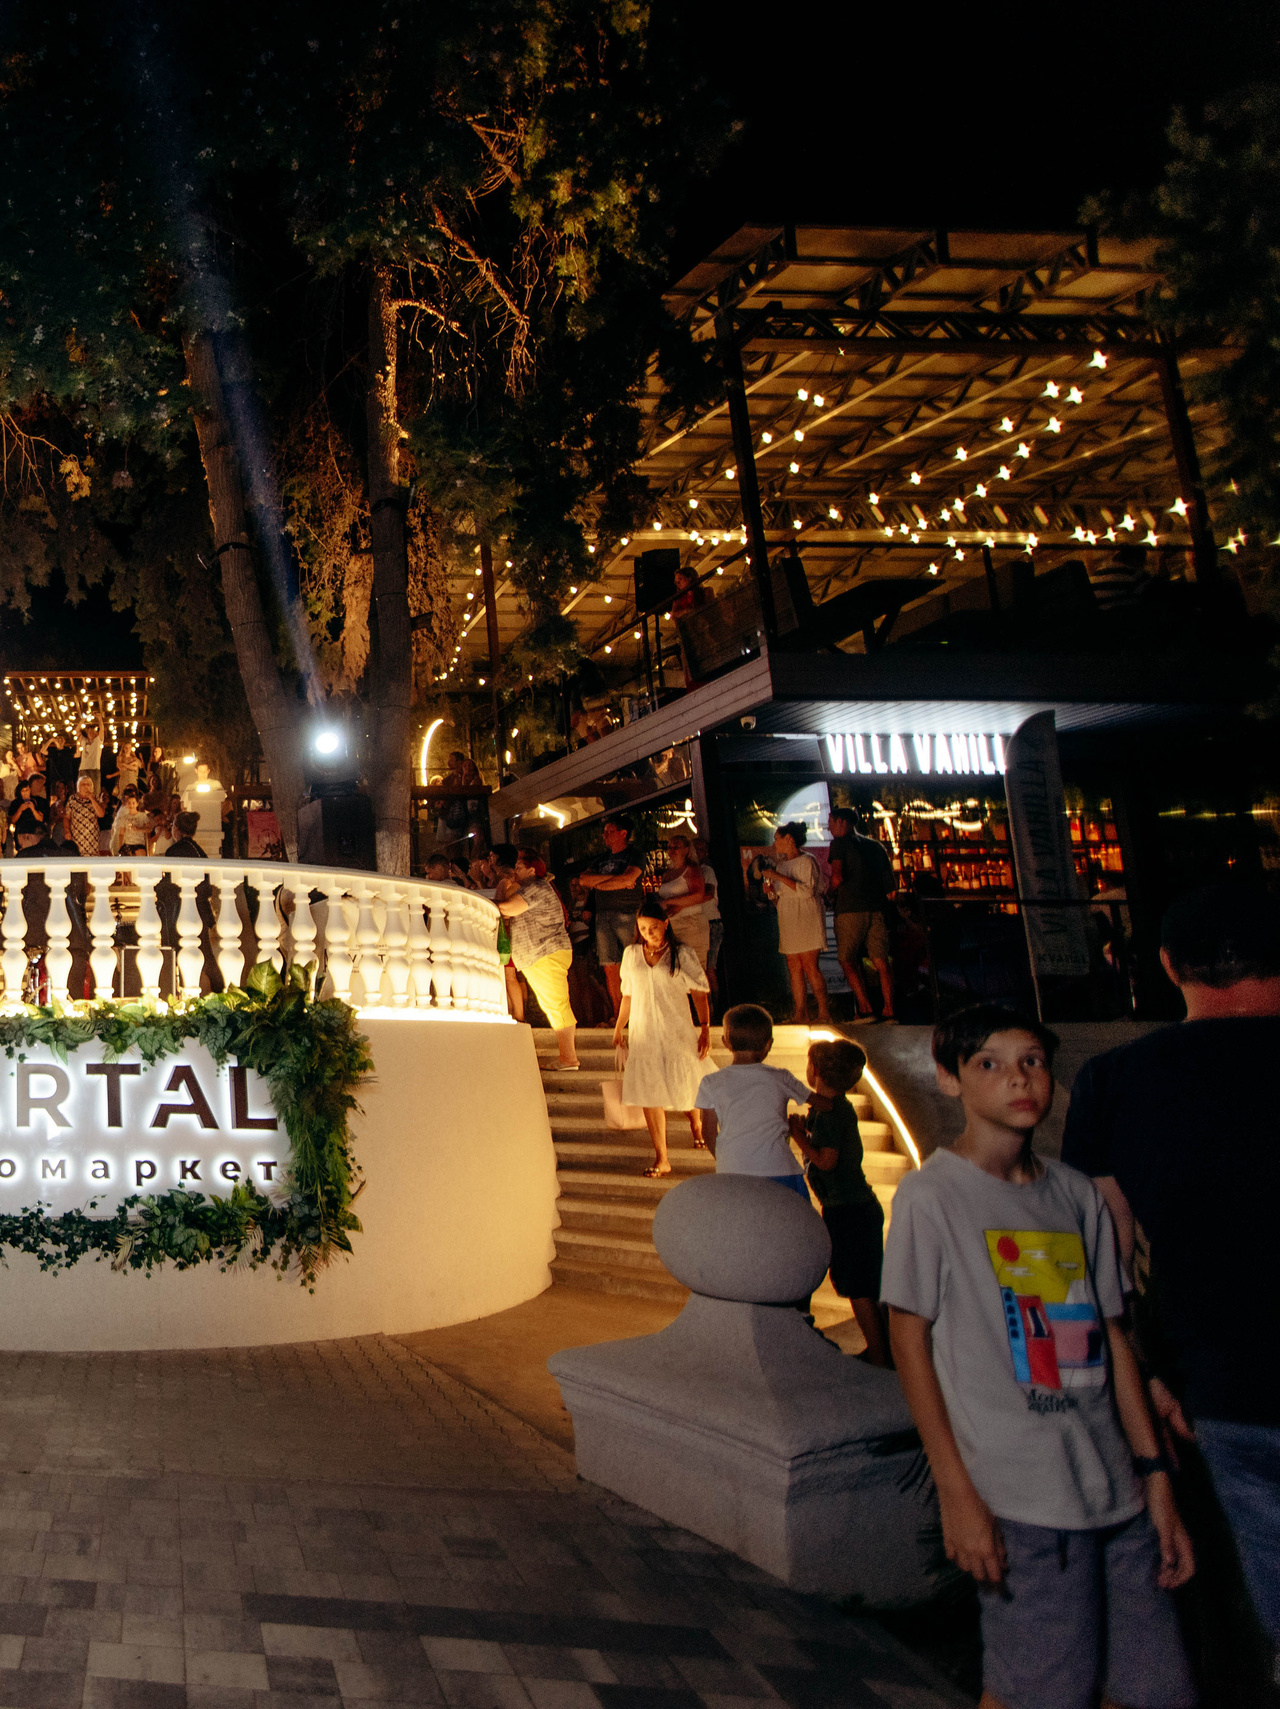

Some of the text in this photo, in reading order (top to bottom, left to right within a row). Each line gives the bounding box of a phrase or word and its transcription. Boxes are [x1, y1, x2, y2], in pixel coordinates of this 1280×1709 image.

[826, 734, 1006, 775] VILLA VANILL
[1036, 867, 1067, 935] VILA
